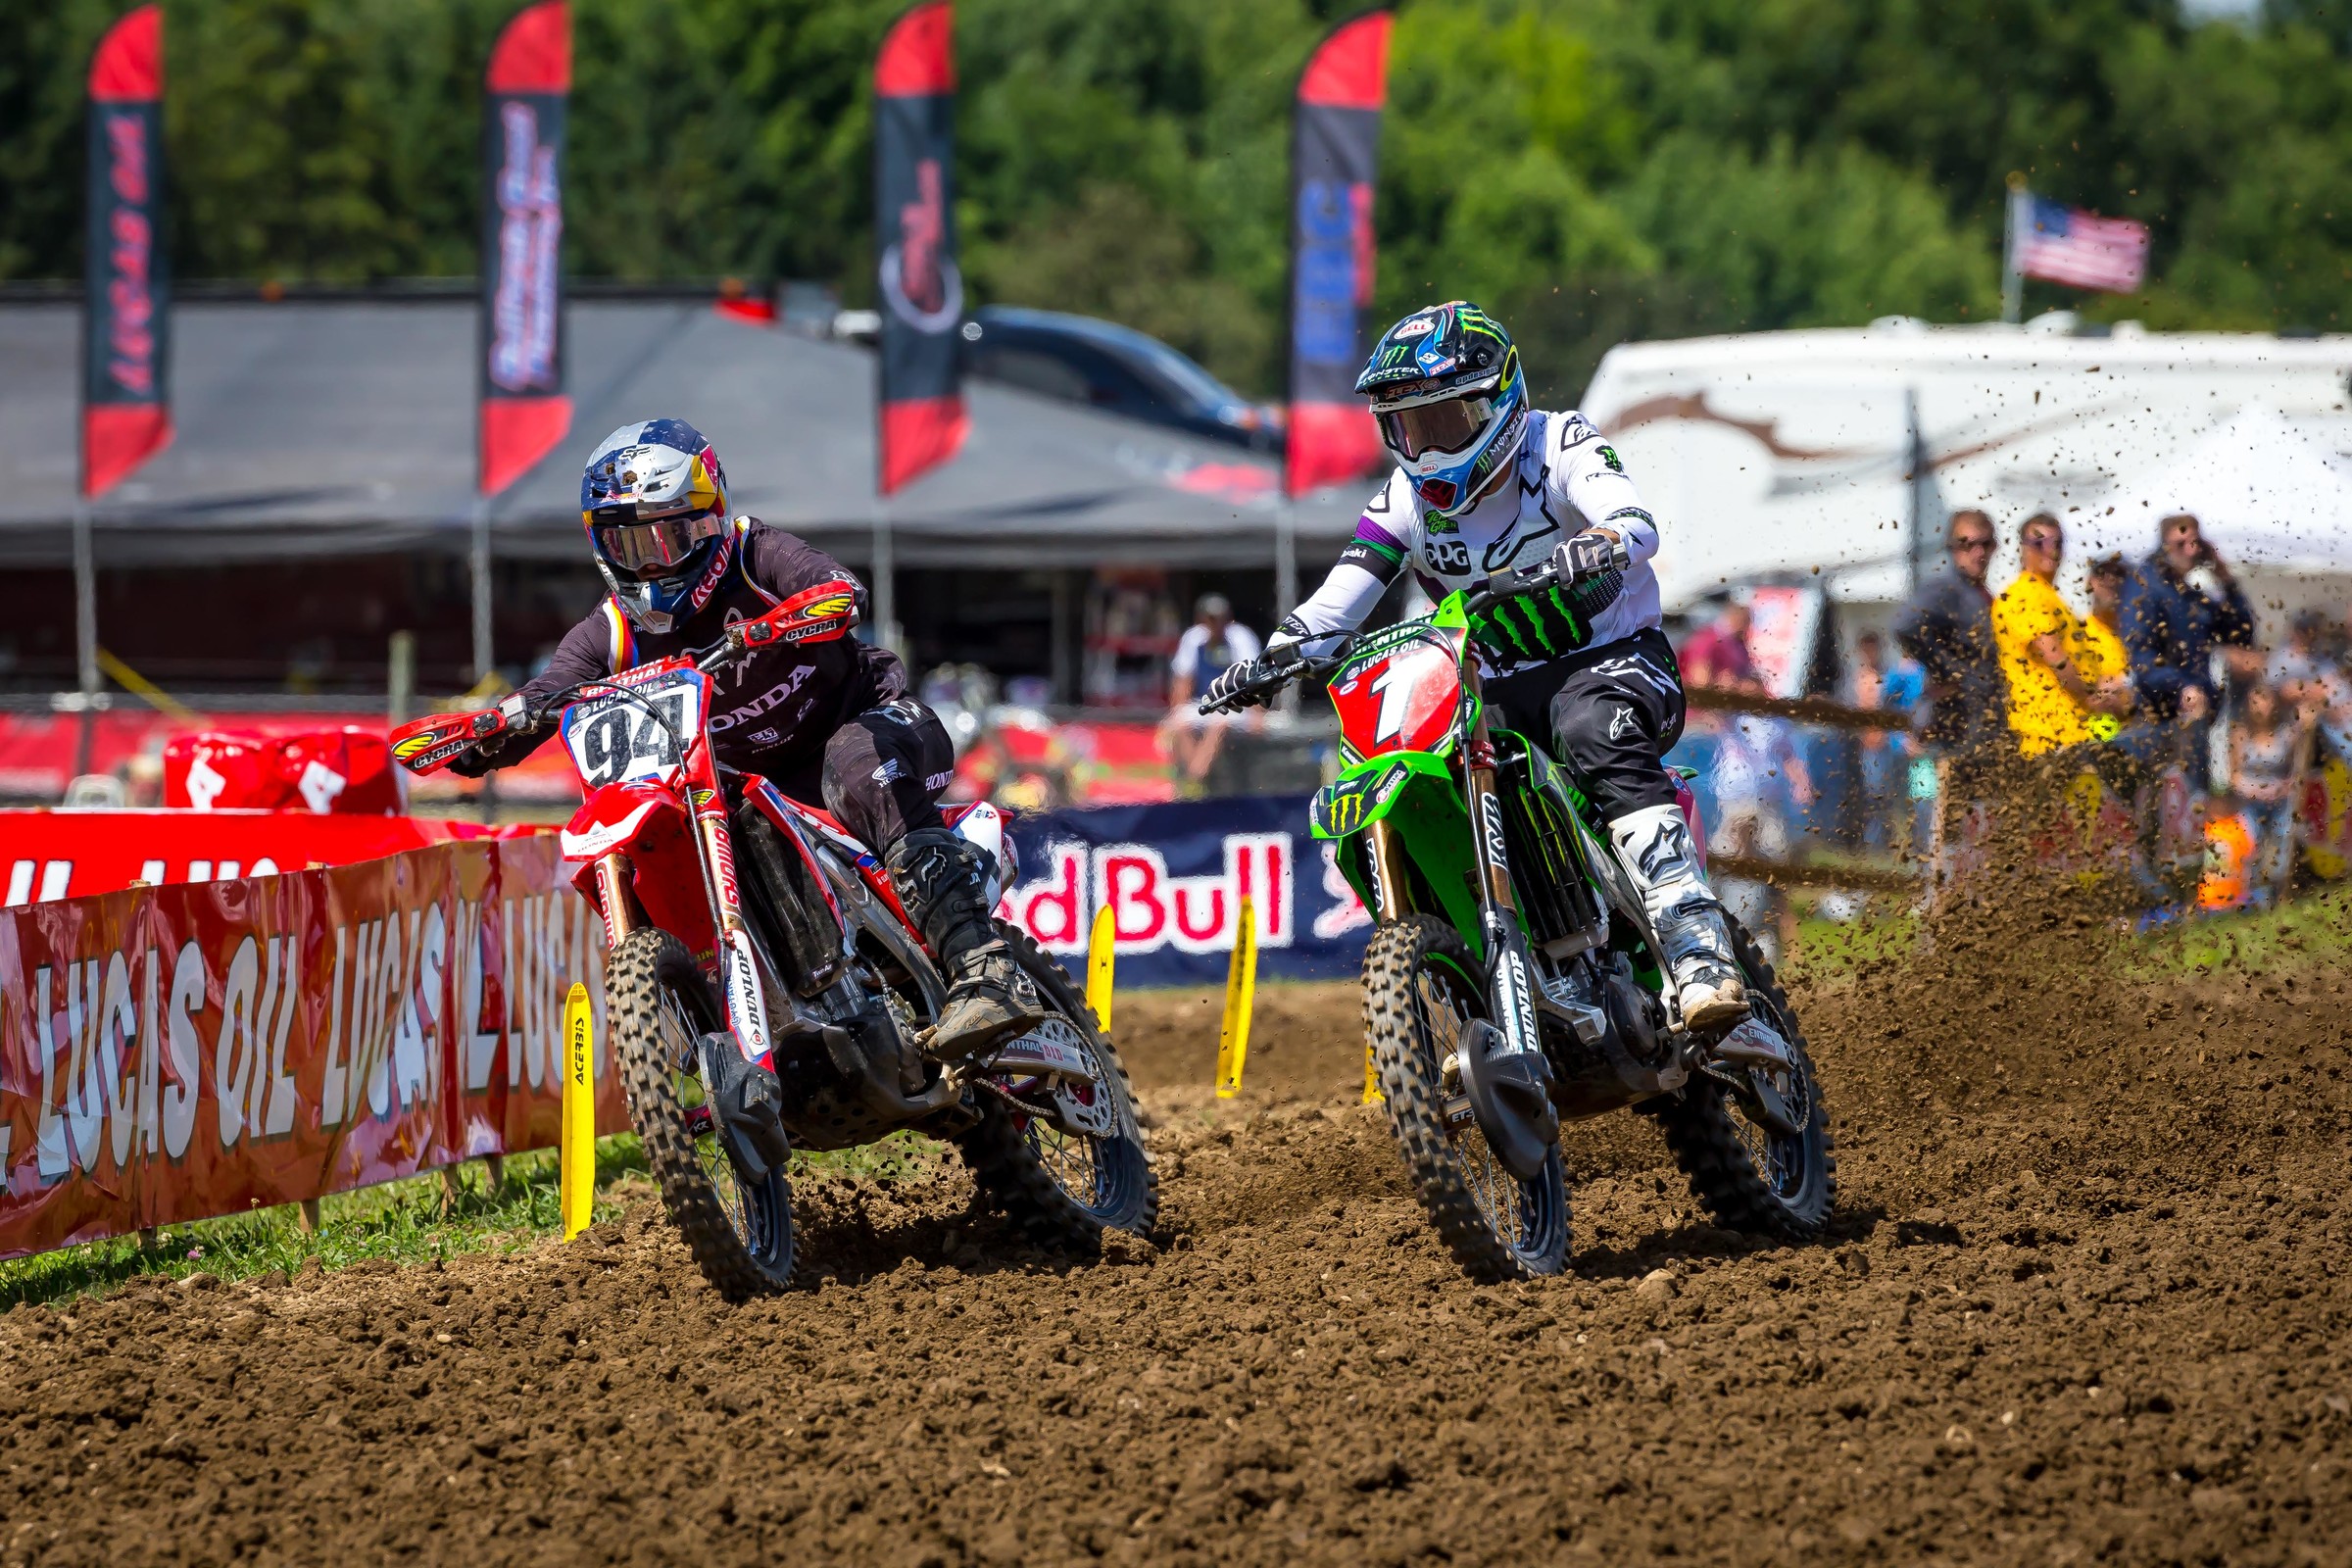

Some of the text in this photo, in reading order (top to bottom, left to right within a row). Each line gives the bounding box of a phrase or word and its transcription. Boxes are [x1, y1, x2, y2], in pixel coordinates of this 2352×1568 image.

[1400, 323, 1427, 334] BELL
[1455, 366, 1499, 384] apdesigns
[785, 618, 837, 642] CYCRA
[1360, 638, 1422, 671] LUCAS OIL
[592, 689, 630, 713] LUCAS
[633, 683, 656, 698] OIL
[708, 664, 816, 733] ONDA
[1368, 649, 1421, 750] 1
[414, 739, 465, 768] CYCRA
[584, 693, 690, 789] 94
[925, 768, 954, 791] HOND
[736, 949, 761, 1028] DUNLOP
[1510, 950, 1542, 1053] DUNLOP
[36, 938, 207, 1176] LUCAS
[216, 934, 296, 1147] OIL
[321, 902, 446, 1126] LUCAS
[575, 1017, 584, 1086] ACERBIS
[1006, 1039, 1044, 1054] NTHAL
